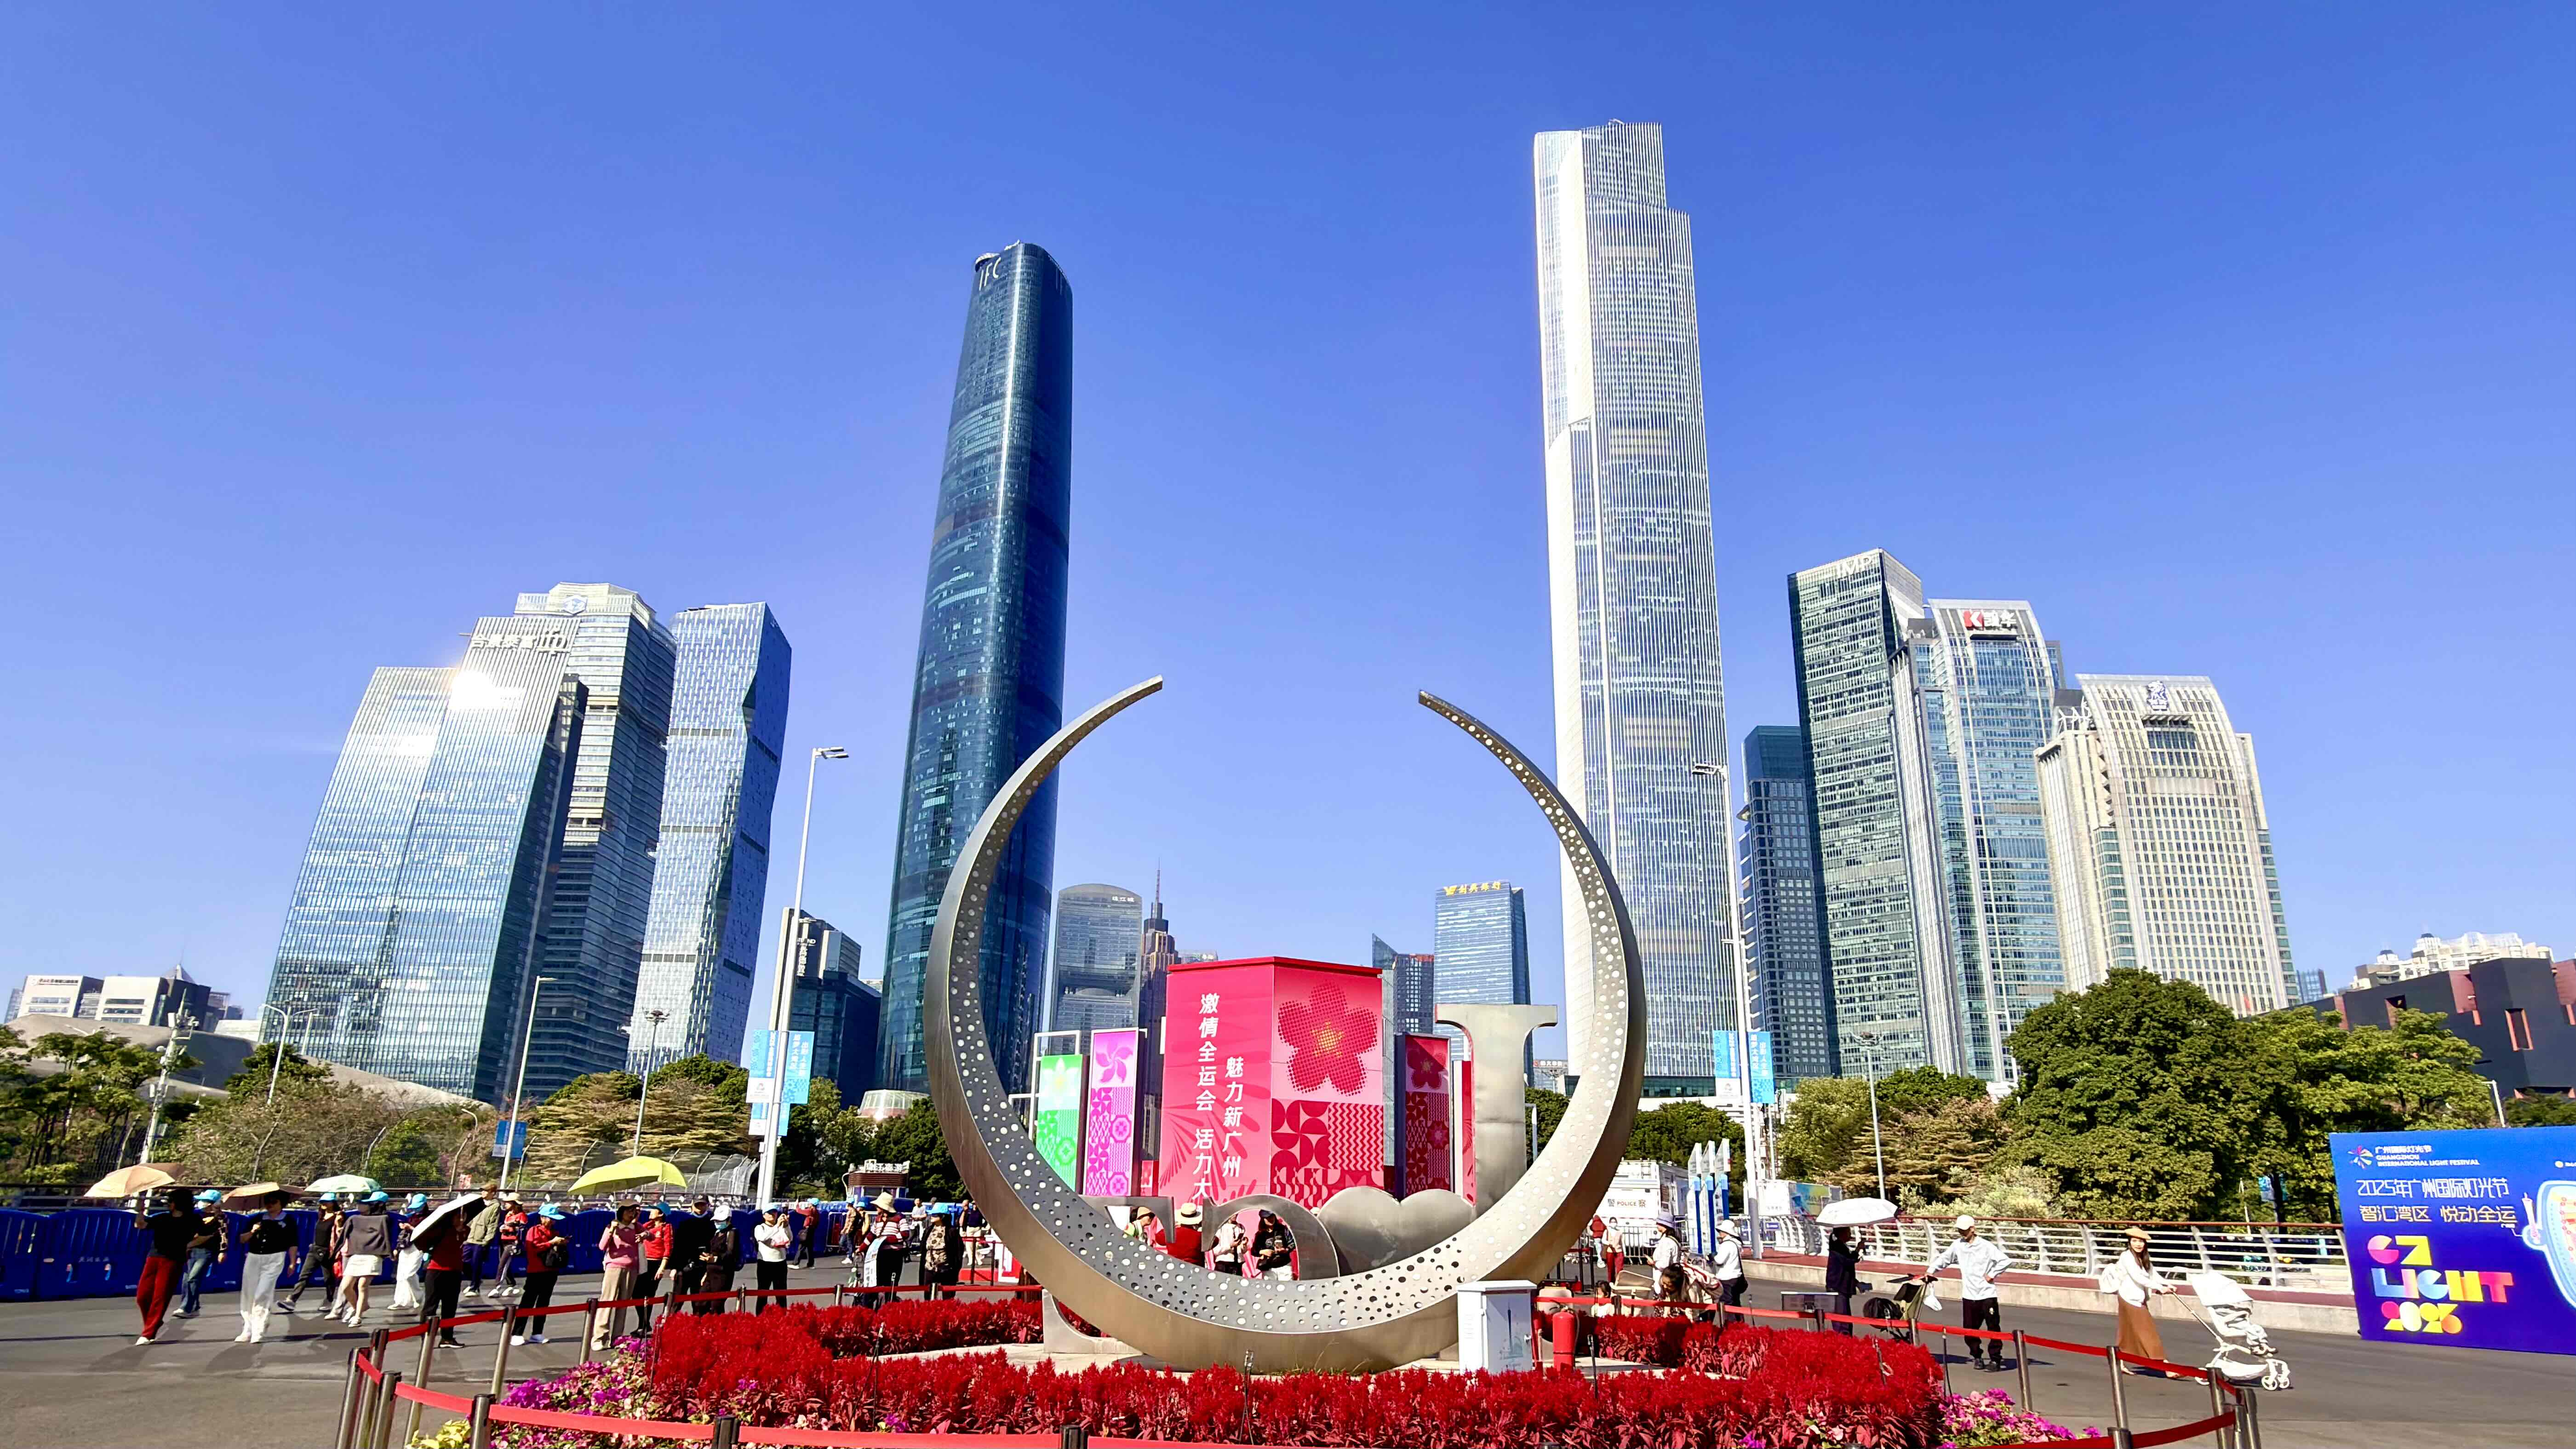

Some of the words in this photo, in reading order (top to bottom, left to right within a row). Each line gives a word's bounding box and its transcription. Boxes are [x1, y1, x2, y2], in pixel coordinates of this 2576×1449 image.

[979, 257, 1001, 292] IFC
[1196, 992, 1220, 1112] 激情全运会
[1222, 1056, 1244, 1178] 魅力新广州
[1192, 1128, 1214, 1201] 活力大
[2375, 1145, 2433, 1154] 广州国际灯光节
[2356, 1177, 2509, 1199] 2025年广州国际灯光节
[2359, 1205, 2433, 1222] 智汇湾区
[2440, 1205, 2517, 1223] 悦动全运
[2371, 1267, 2514, 1303] LIGHT
